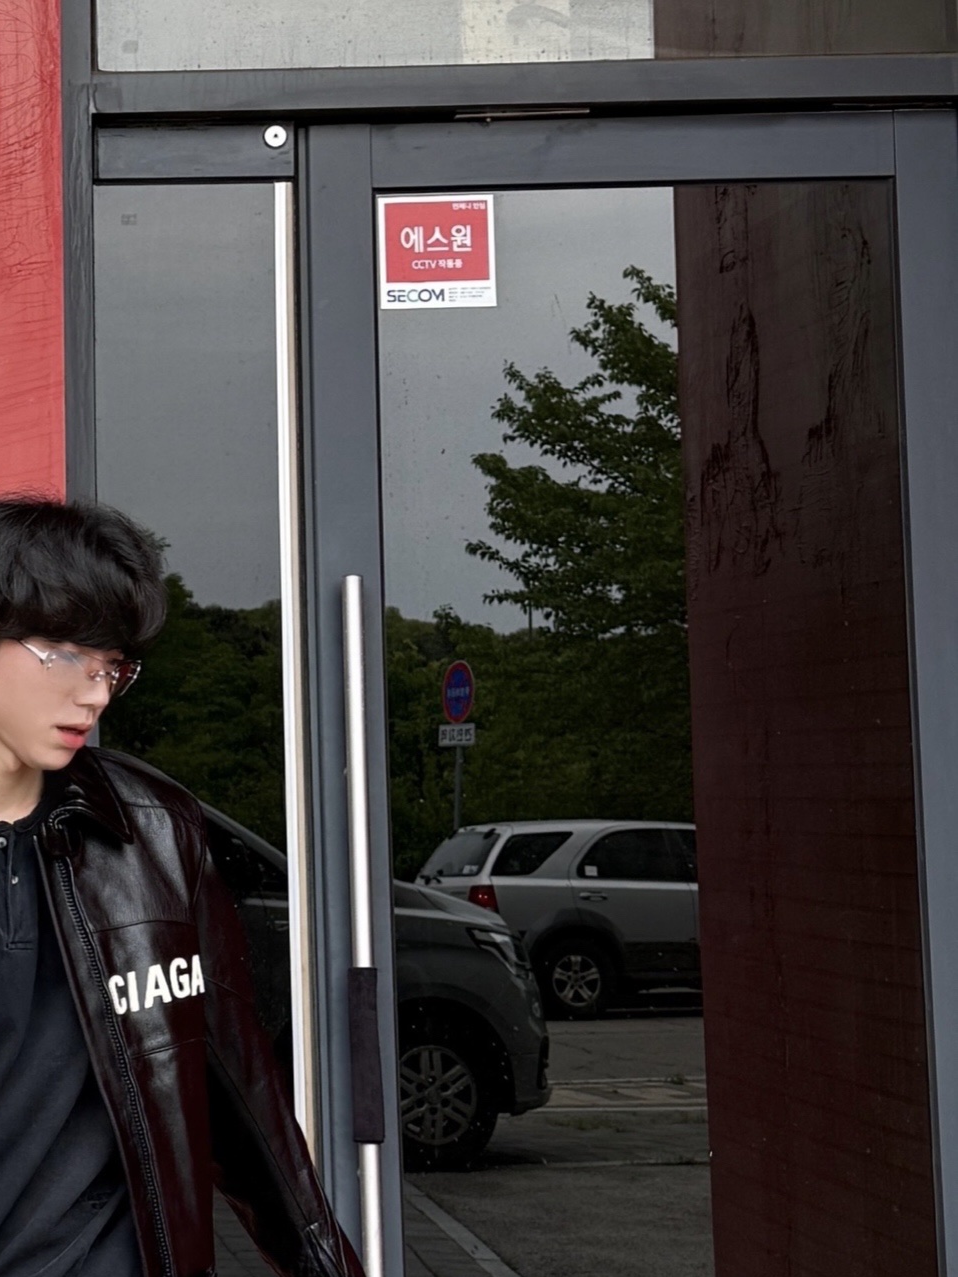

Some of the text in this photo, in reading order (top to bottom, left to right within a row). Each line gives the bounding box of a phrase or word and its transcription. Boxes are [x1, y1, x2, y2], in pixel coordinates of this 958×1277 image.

[400, 224, 472, 253] 에스원
[412, 260, 437, 269] CCTV
[387, 288, 445, 302] SECOM
